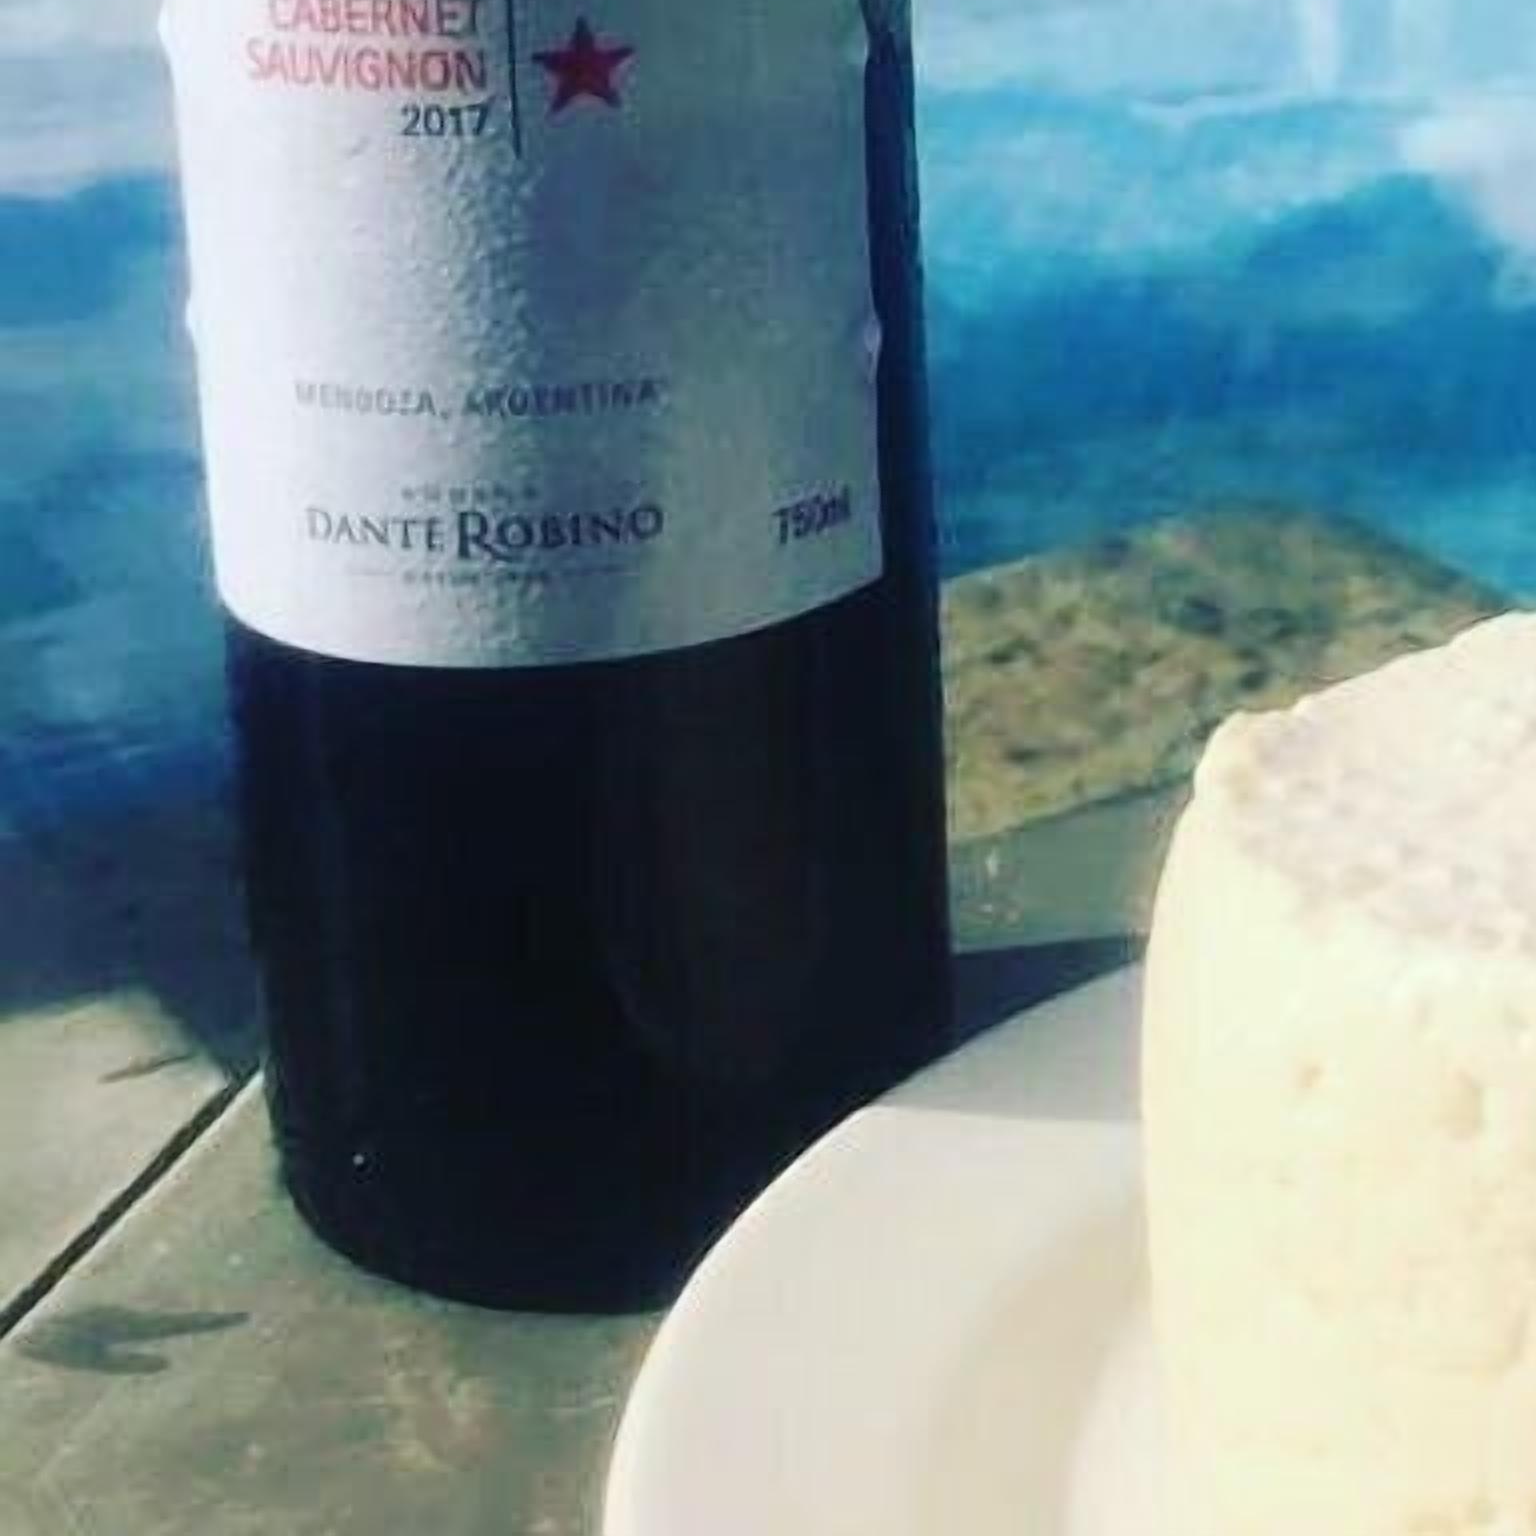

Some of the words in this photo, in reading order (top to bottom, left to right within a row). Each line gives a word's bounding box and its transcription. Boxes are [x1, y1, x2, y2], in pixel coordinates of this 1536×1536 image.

[248, 42, 486, 93] SAUVIGNON
[401, 104, 488, 137] 2017
[306, 508, 445, 550] DANTE
